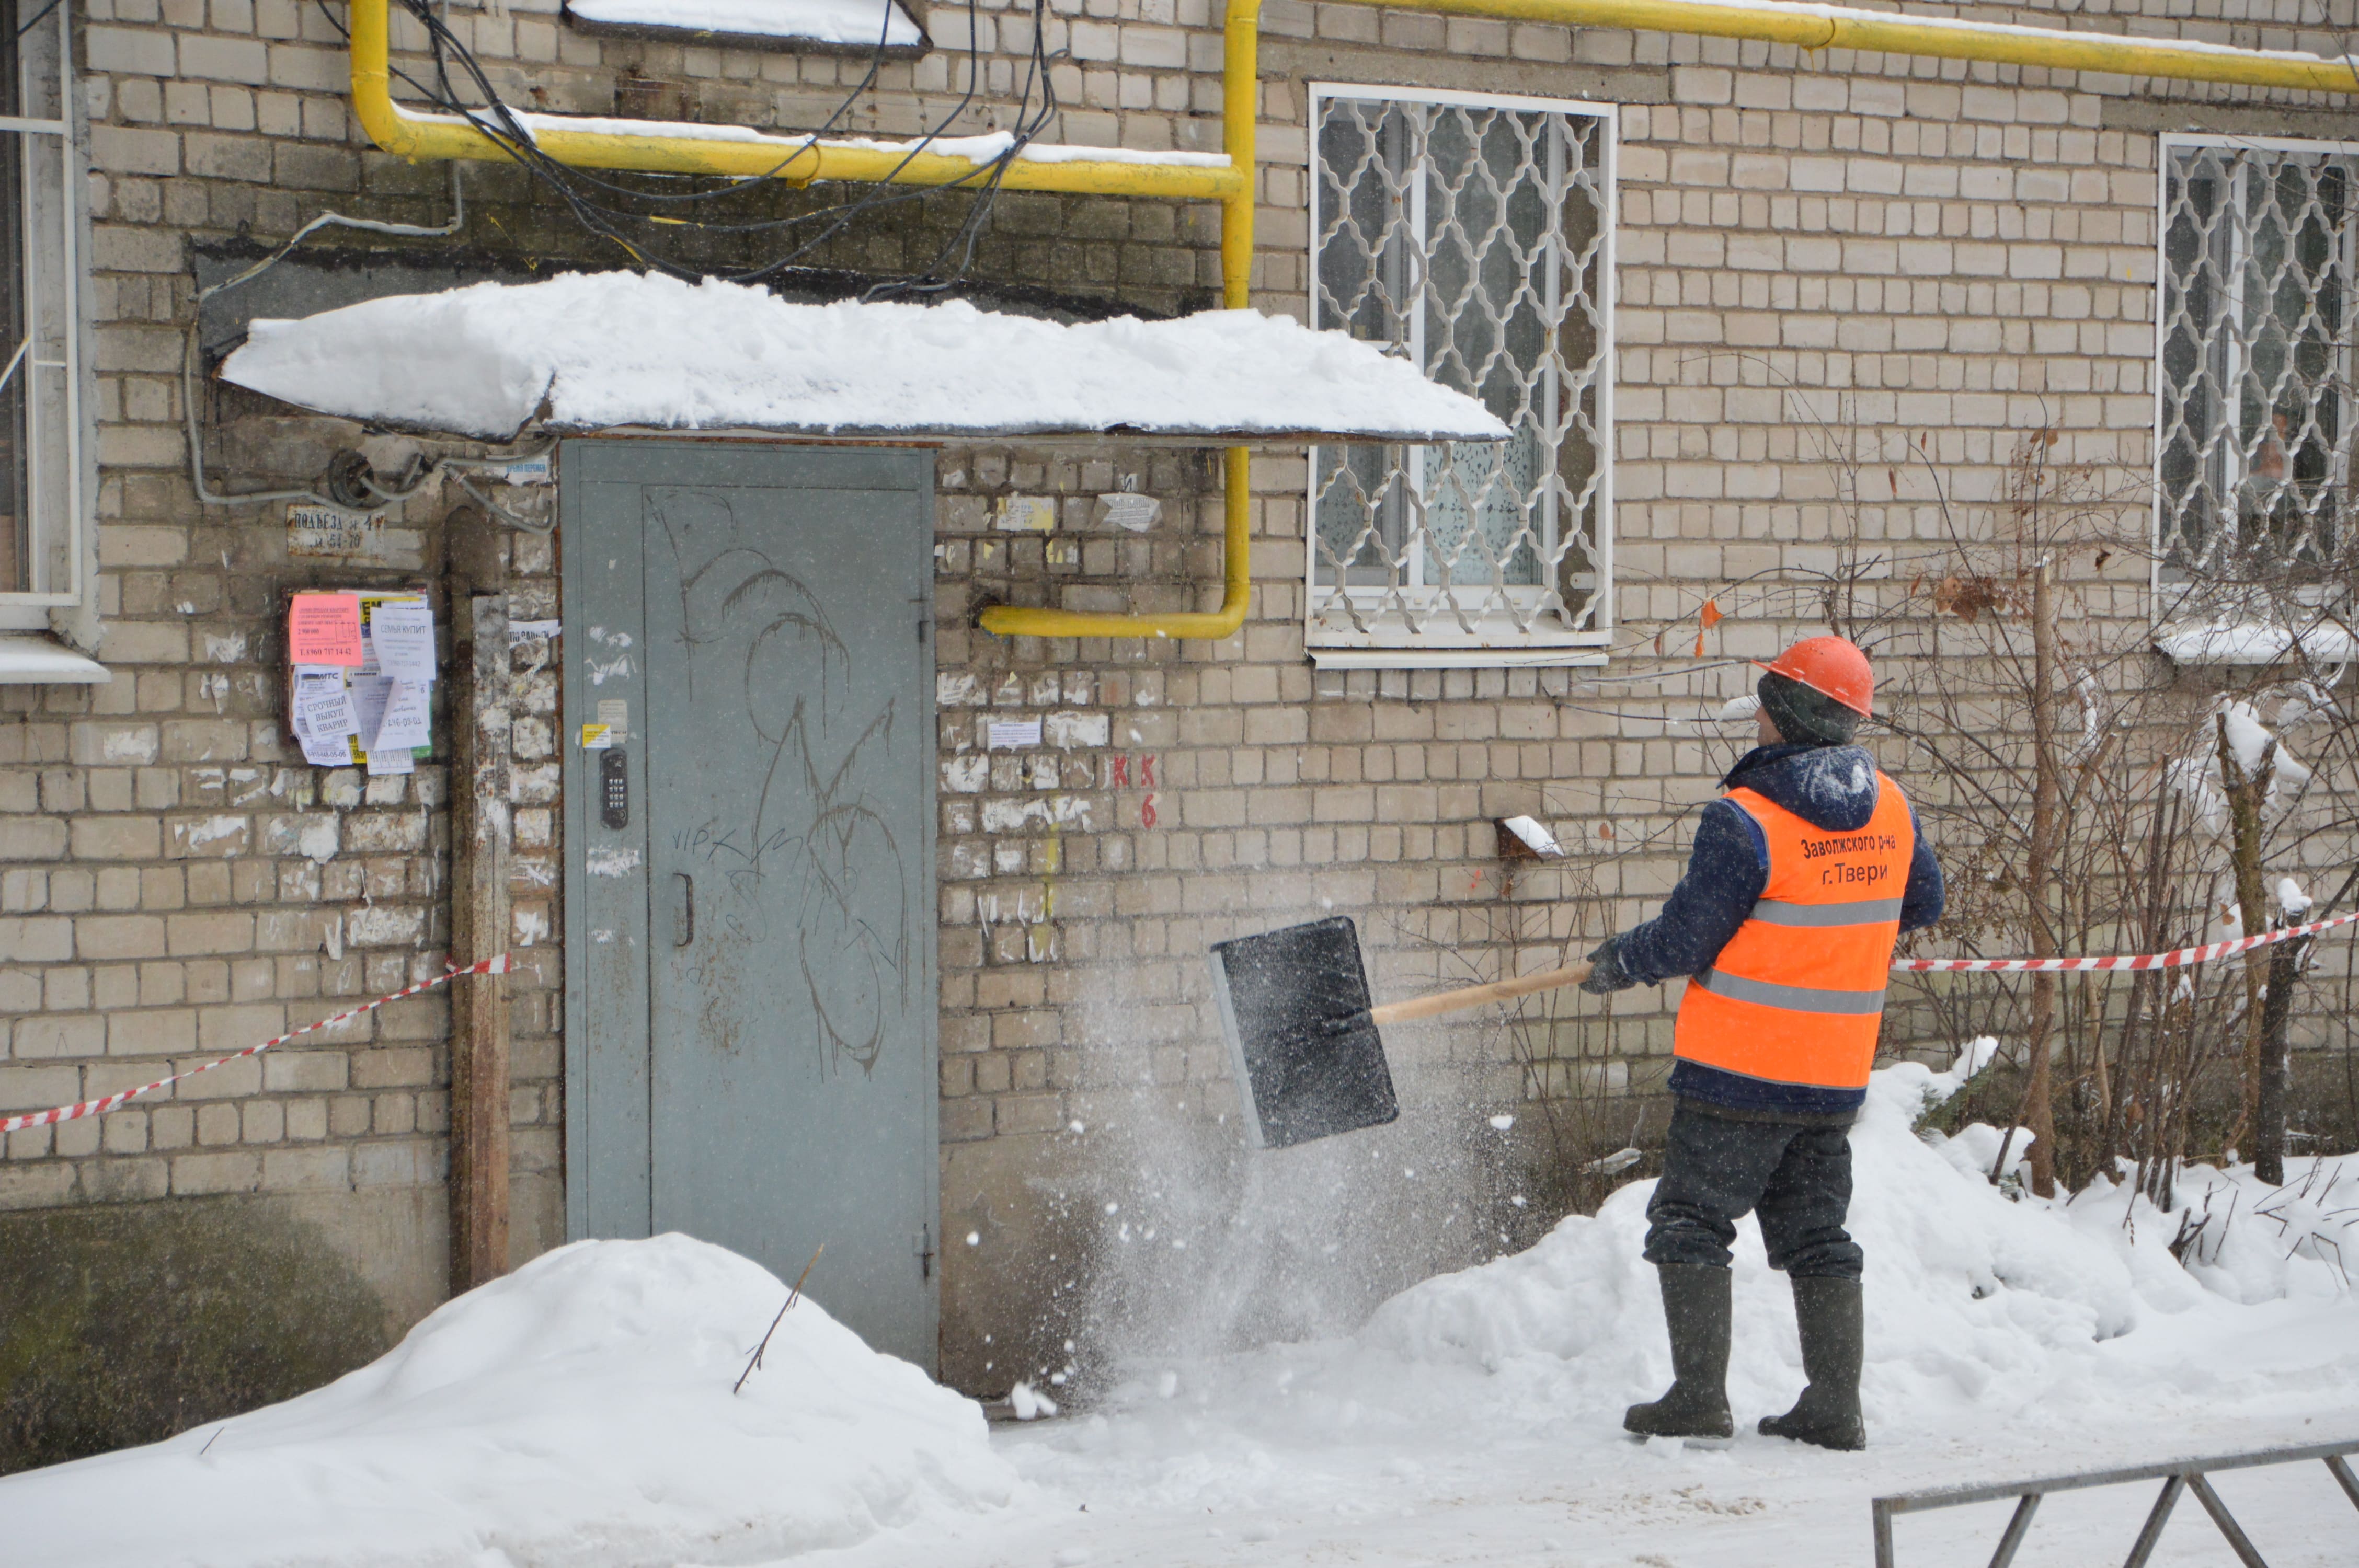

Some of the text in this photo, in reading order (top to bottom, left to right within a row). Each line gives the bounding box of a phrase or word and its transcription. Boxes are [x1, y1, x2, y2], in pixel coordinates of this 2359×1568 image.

[381, 624, 426, 635] СЕМЬЯ КУПИТ
[307, 695, 347, 712] СРОЧНЫЙ
[315, 708, 344, 722] ВЫКУП
[317, 719, 348, 733] КВАРИР
[1141, 793, 1156, 829] 6
[673, 827, 709, 855] VIP
[1801, 834, 1897, 859] Заволжского р-на
